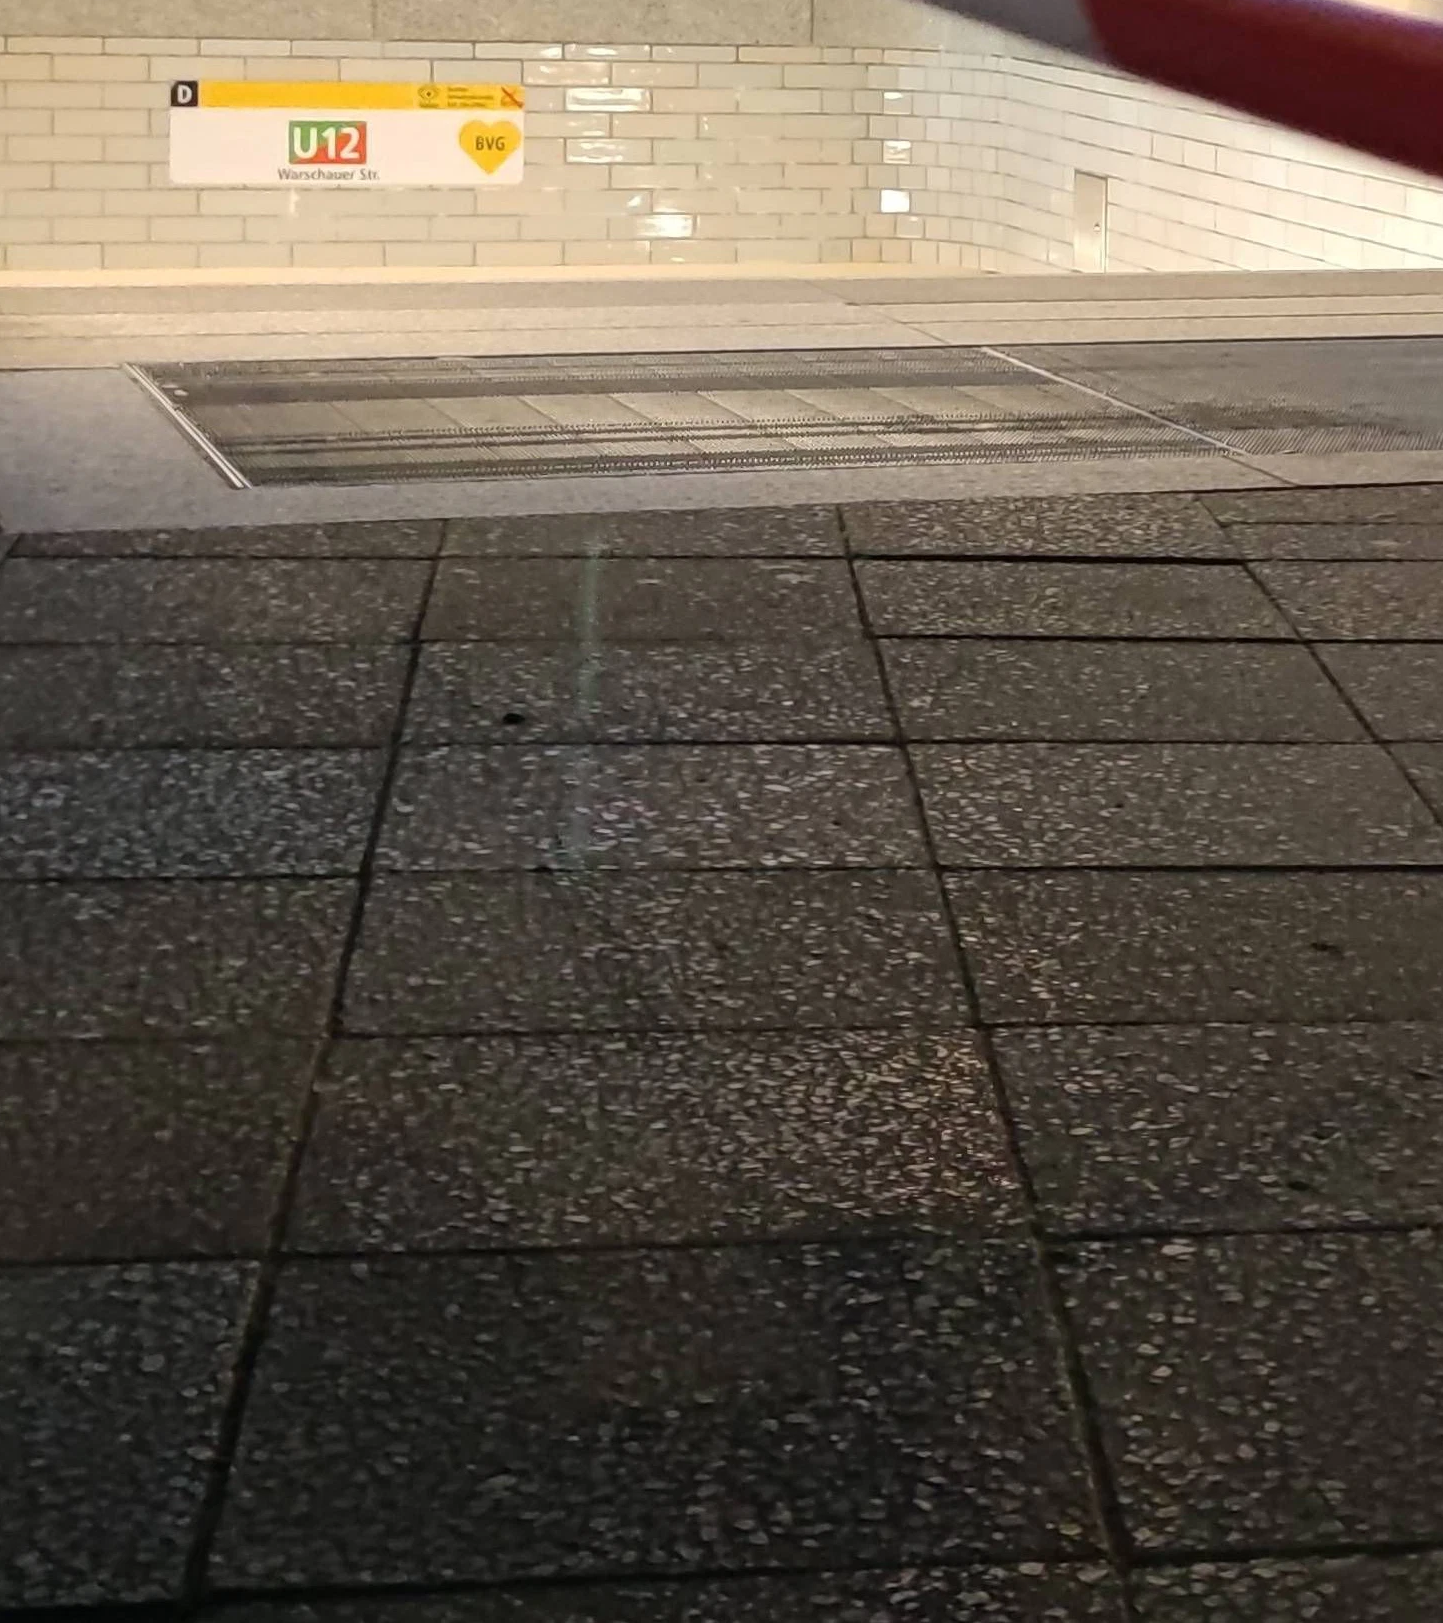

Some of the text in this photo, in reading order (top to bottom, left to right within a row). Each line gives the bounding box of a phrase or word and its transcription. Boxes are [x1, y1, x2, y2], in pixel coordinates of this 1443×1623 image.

[176, 84, 192, 105] D
[293, 126, 360, 160] U12
[474, 136, 506, 152] BVG
[277, 167, 355, 181] Warschauer
